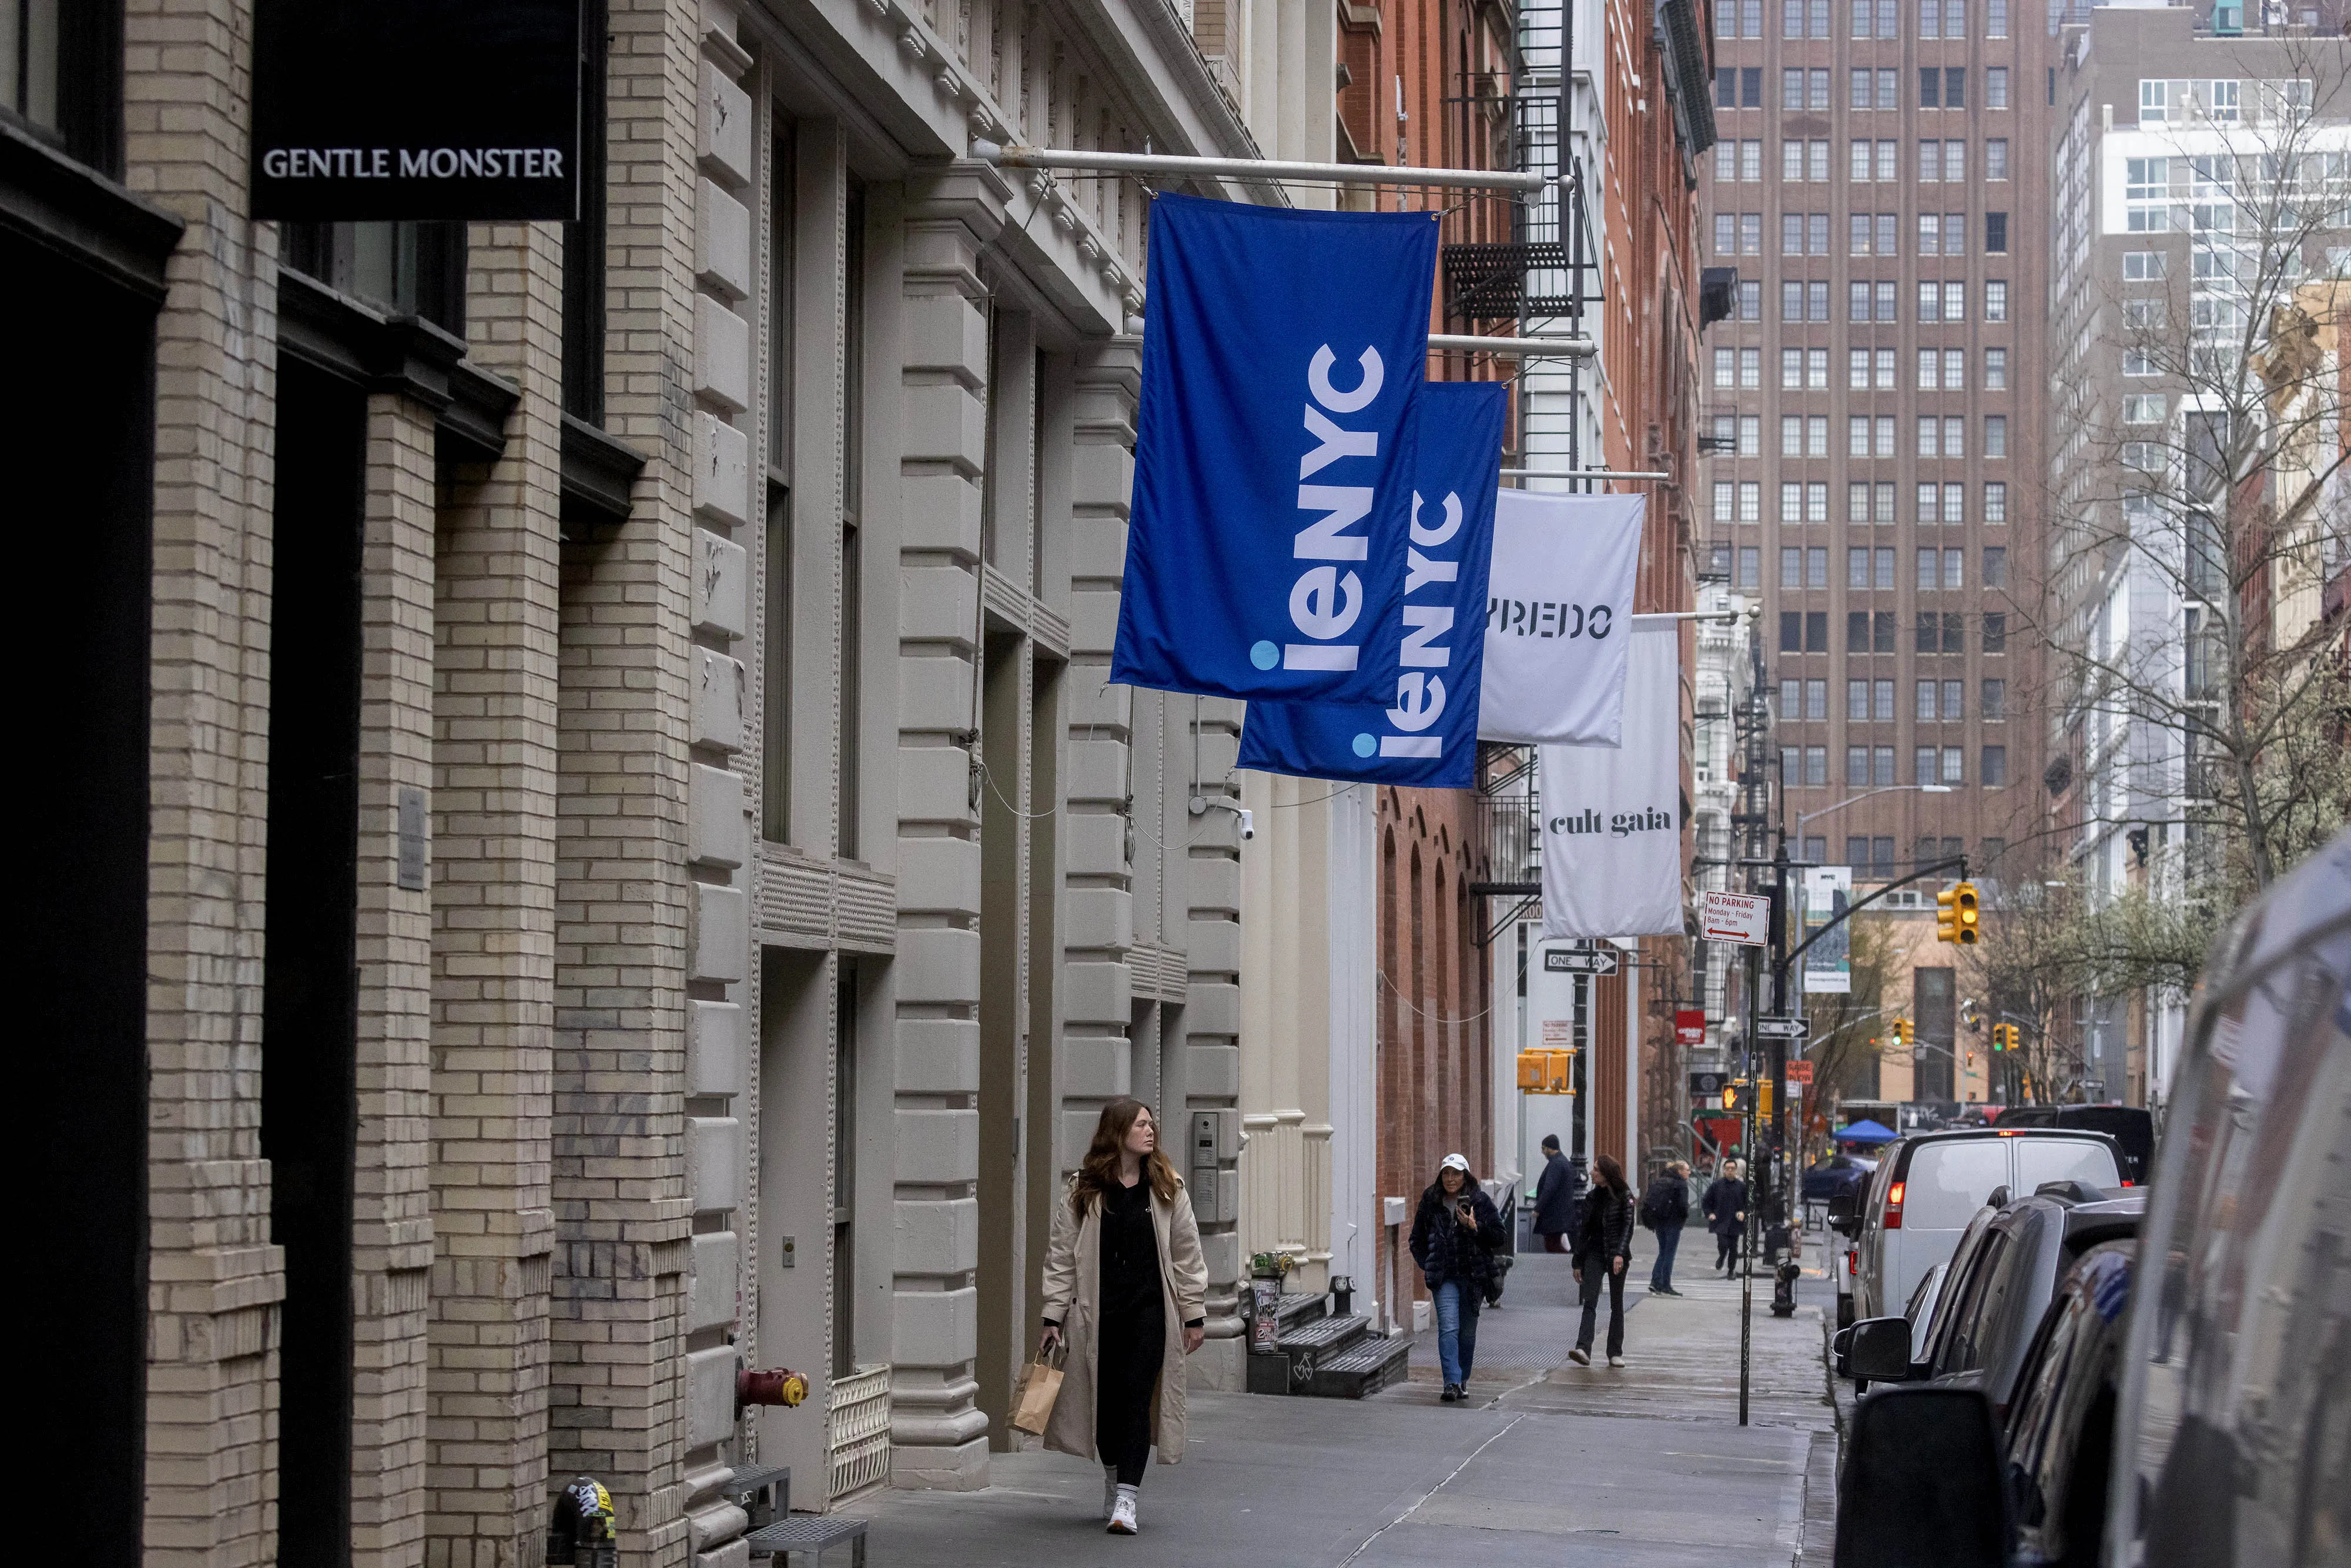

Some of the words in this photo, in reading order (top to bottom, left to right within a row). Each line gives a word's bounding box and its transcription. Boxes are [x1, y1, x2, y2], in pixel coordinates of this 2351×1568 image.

[263, 149, 390, 177] GENTLE
[399, 148, 564, 177] MONSTER
[1550, 809, 1604, 835] cult
[1610, 806, 1670, 839] gaia
[1709, 896, 1720, 905] NO
[1722, 897, 1754, 909] PARKING
[1708, 907, 1730, 917] Monday
[1736, 910, 1753, 920] Friday
[1725, 919, 1738, 927] 6pm
[1550, 956, 1572, 966] ONE
